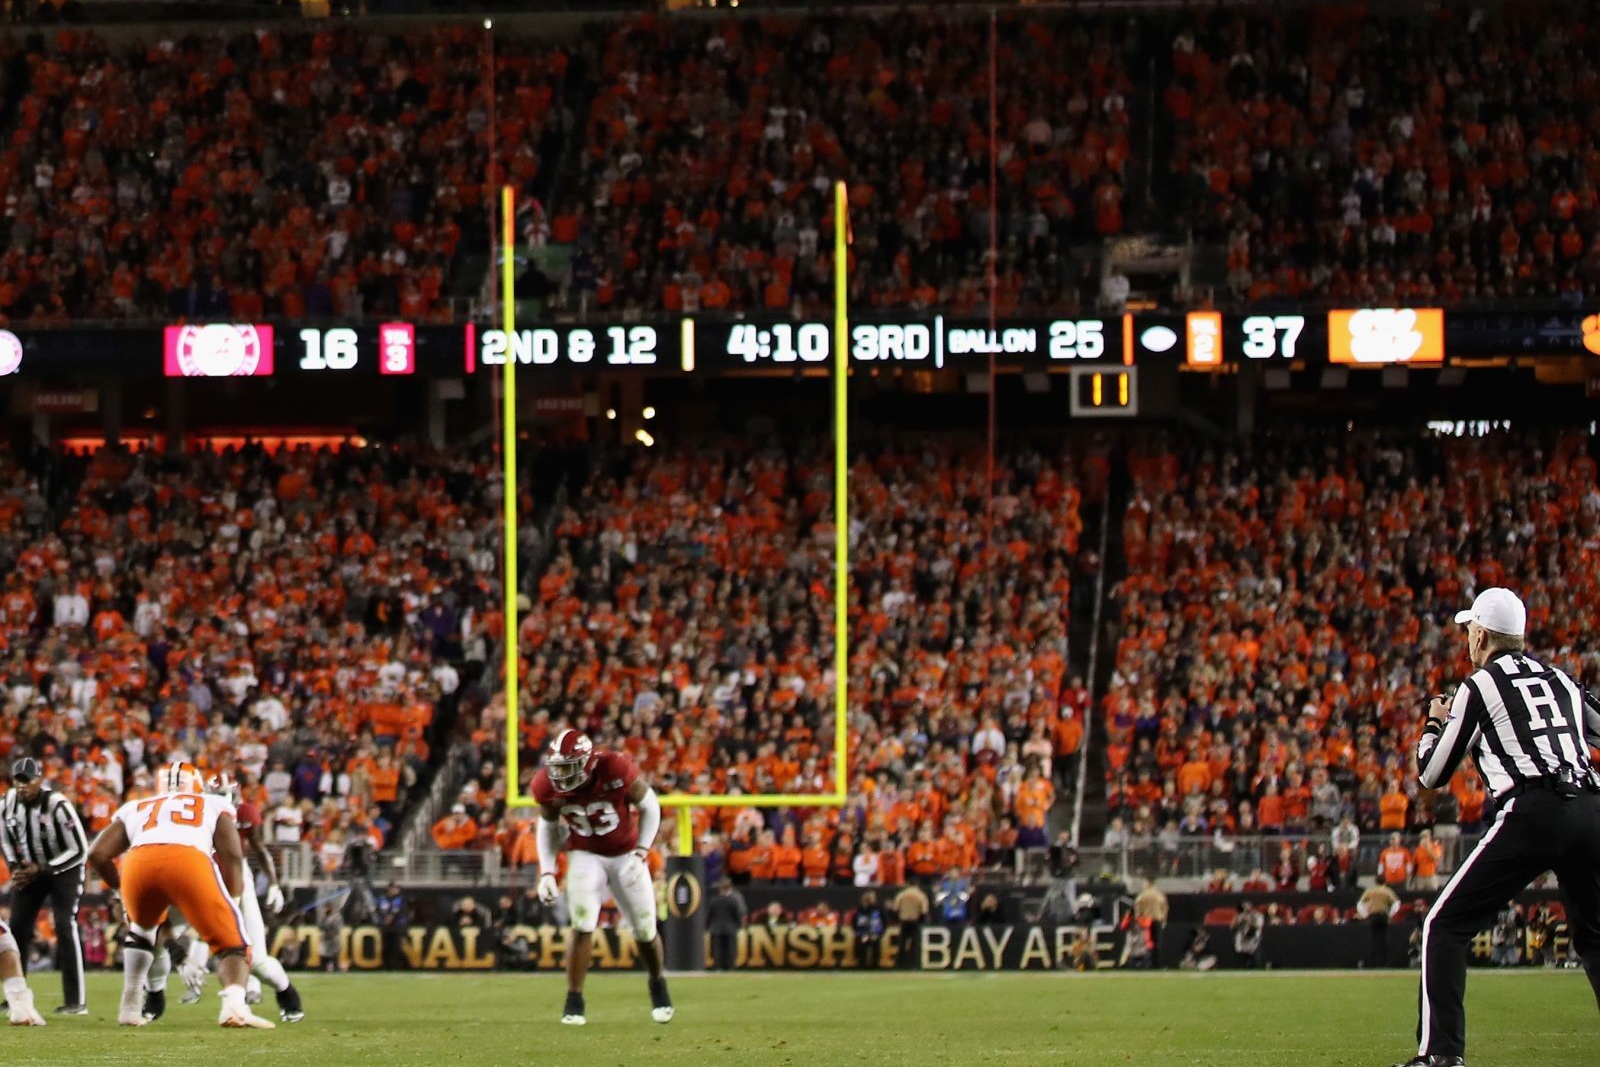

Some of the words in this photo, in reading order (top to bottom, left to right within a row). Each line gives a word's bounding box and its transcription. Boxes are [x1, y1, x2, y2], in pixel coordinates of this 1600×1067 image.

[299, 327, 358, 370] 16
[482, 329, 558, 365] 2ND
[607, 326, 657, 365] 12
[727, 323, 830, 362] 4:10
[852, 325, 930, 361] 3RD
[1048, 320, 1104, 360] 25
[1242, 316, 1305, 359] 37
[1092, 372, 1128, 406] 11
[1511, 676, 1568, 730] R
[136, 793, 204, 832] 73
[560, 801, 620, 837] 33
[921, 926, 1014, 970] BAY
